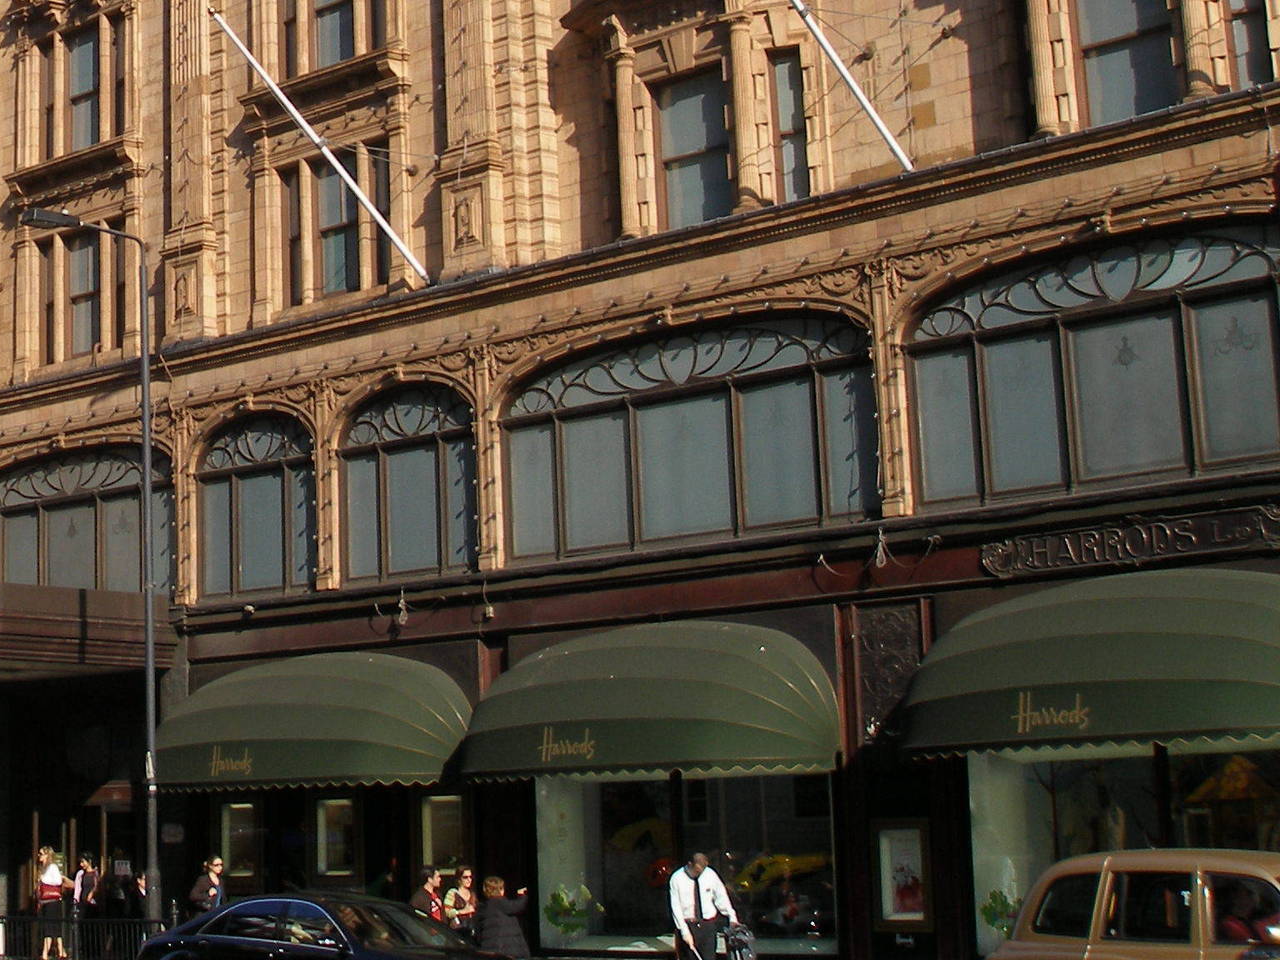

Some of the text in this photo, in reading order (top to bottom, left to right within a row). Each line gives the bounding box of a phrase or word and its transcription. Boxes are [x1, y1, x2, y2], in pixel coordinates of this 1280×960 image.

[1029, 520, 1198, 568] HARRODS
[1010, 691, 1089, 734] Harrods
[208, 744, 252, 777] Harrods
[536, 726, 595, 761] Harrods
